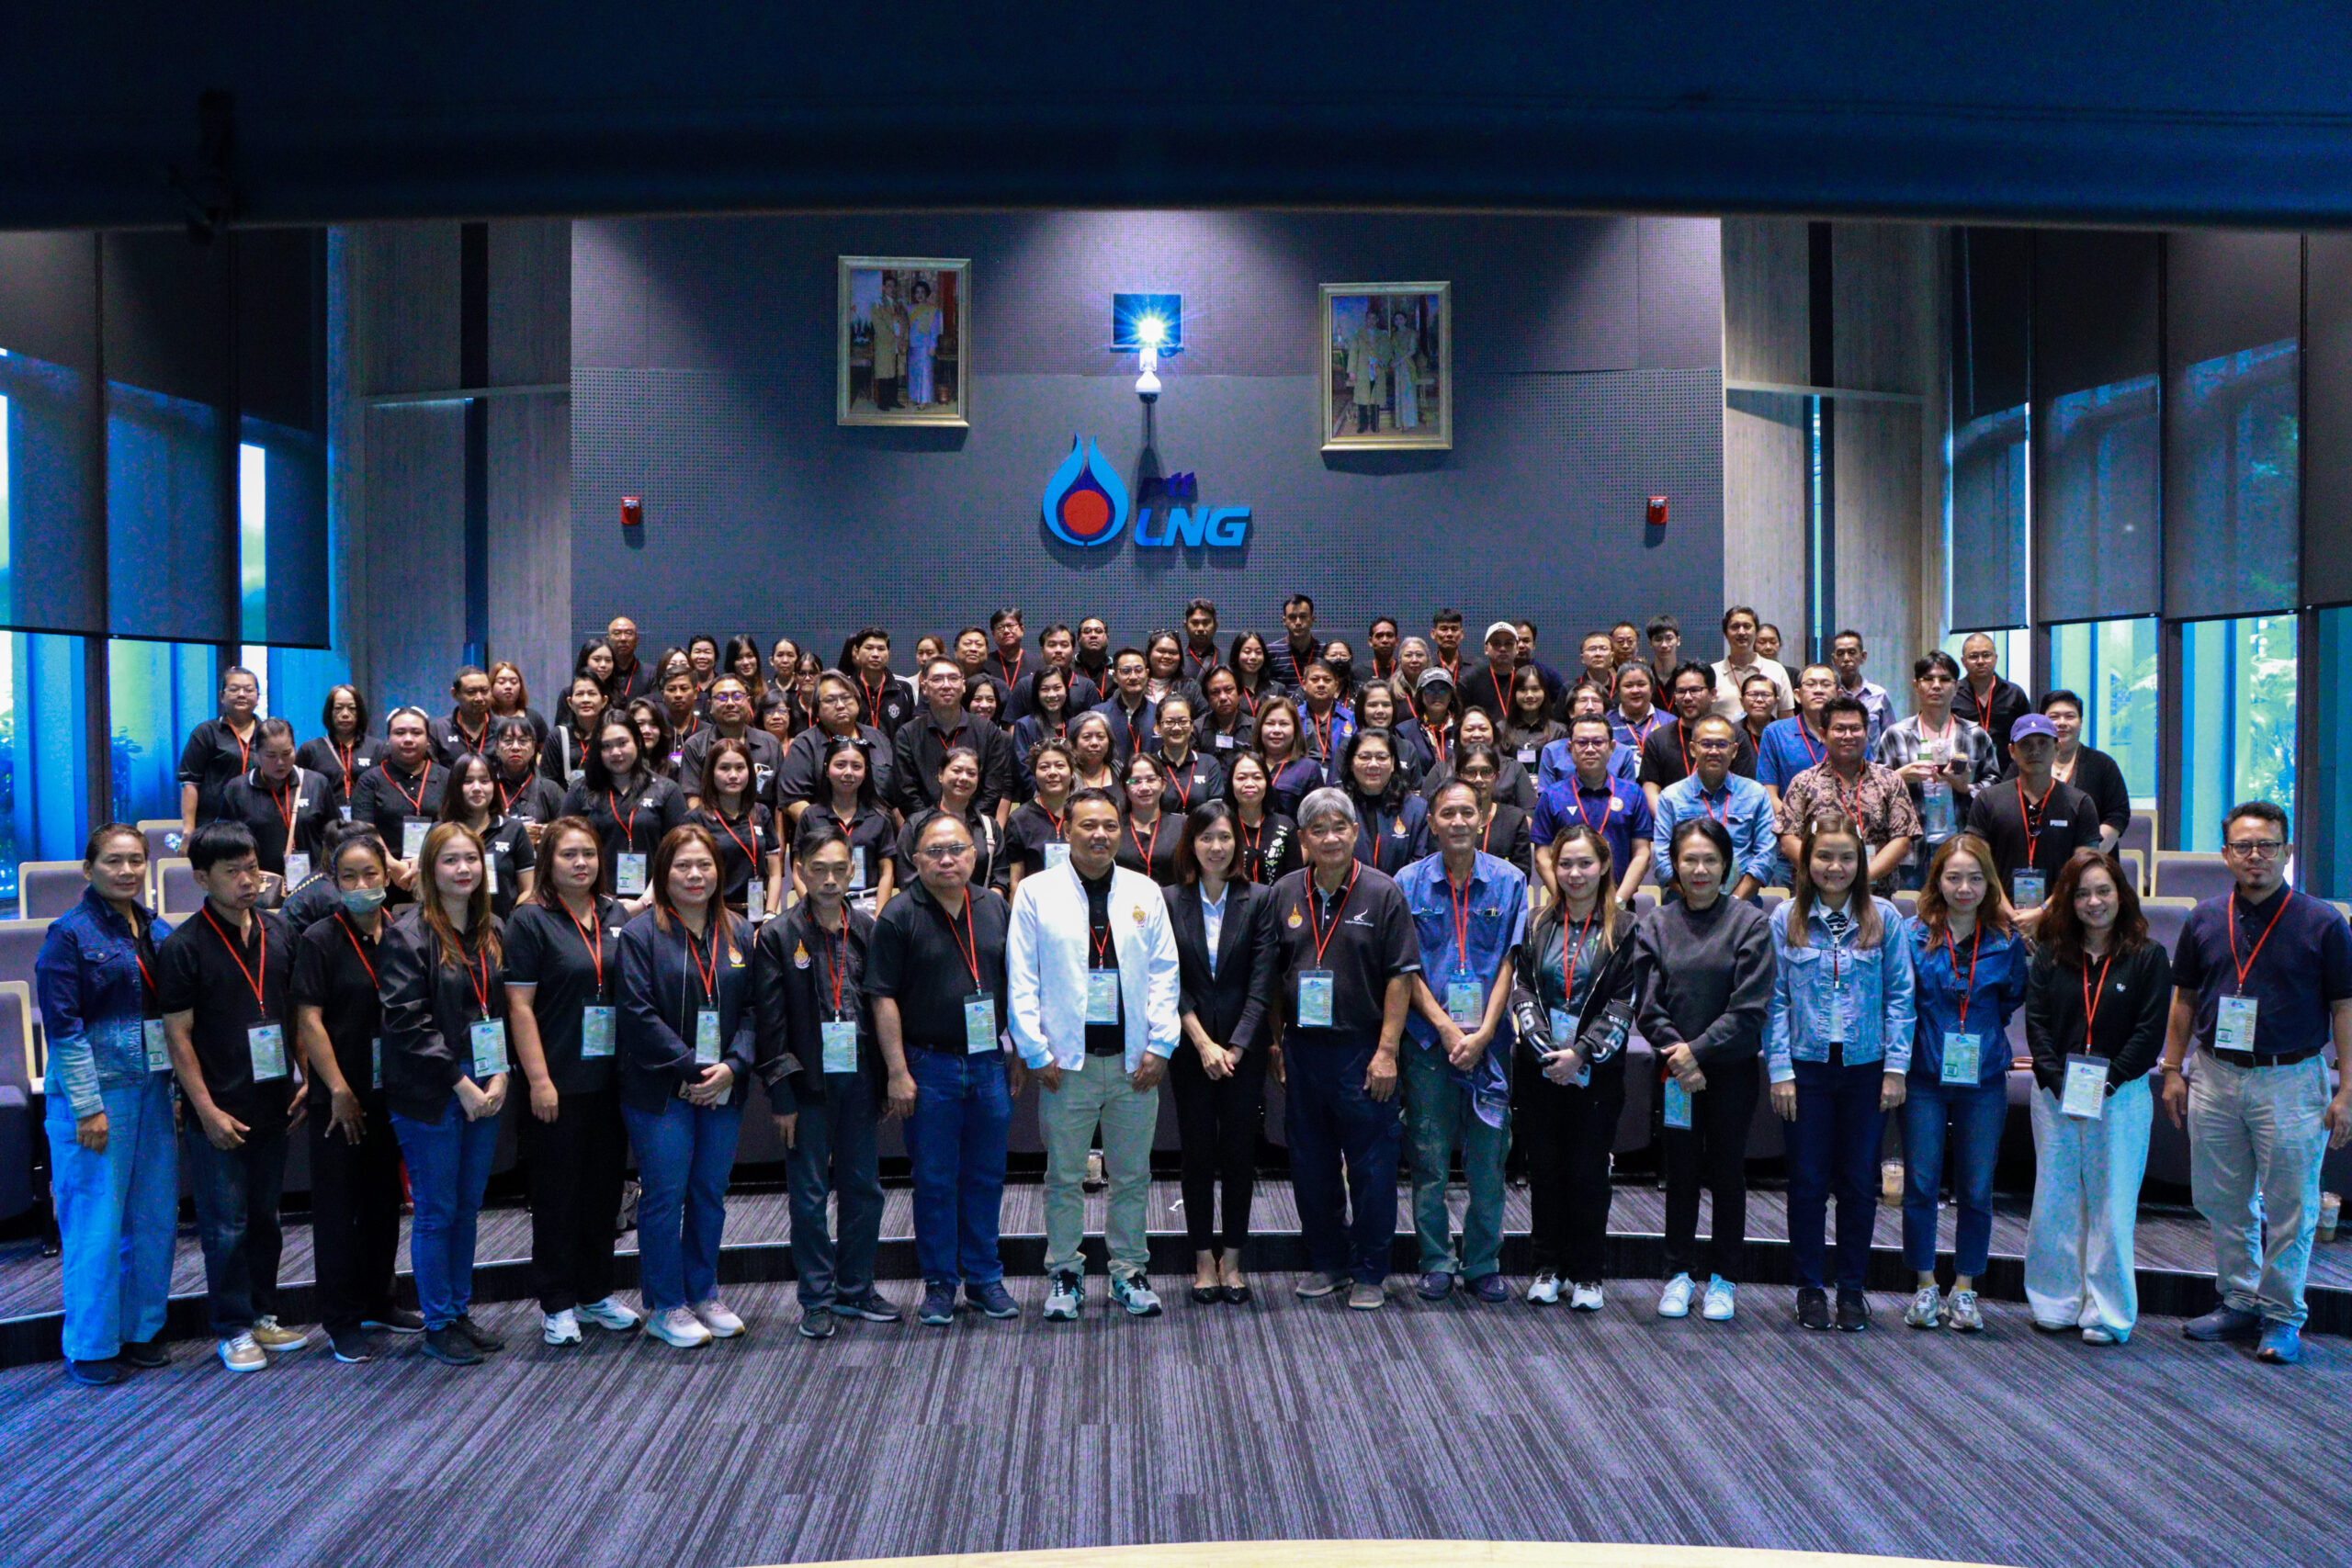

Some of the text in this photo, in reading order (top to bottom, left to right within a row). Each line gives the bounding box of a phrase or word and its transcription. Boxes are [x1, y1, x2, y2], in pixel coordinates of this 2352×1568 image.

[1134, 507, 1250, 547] LNG
[1105, 985, 1114, 1016] VISITOR
[986, 1011, 995, 1043] VISITOR
[2243, 1012, 2255, 1044] VISITOR
[496, 1034, 507, 1066] VISITOR
[846, 1035, 854, 1066] VISITOR
[1968, 1046, 1978, 1078] VISITOR
[2090, 1079, 2102, 1111] VISITOR
